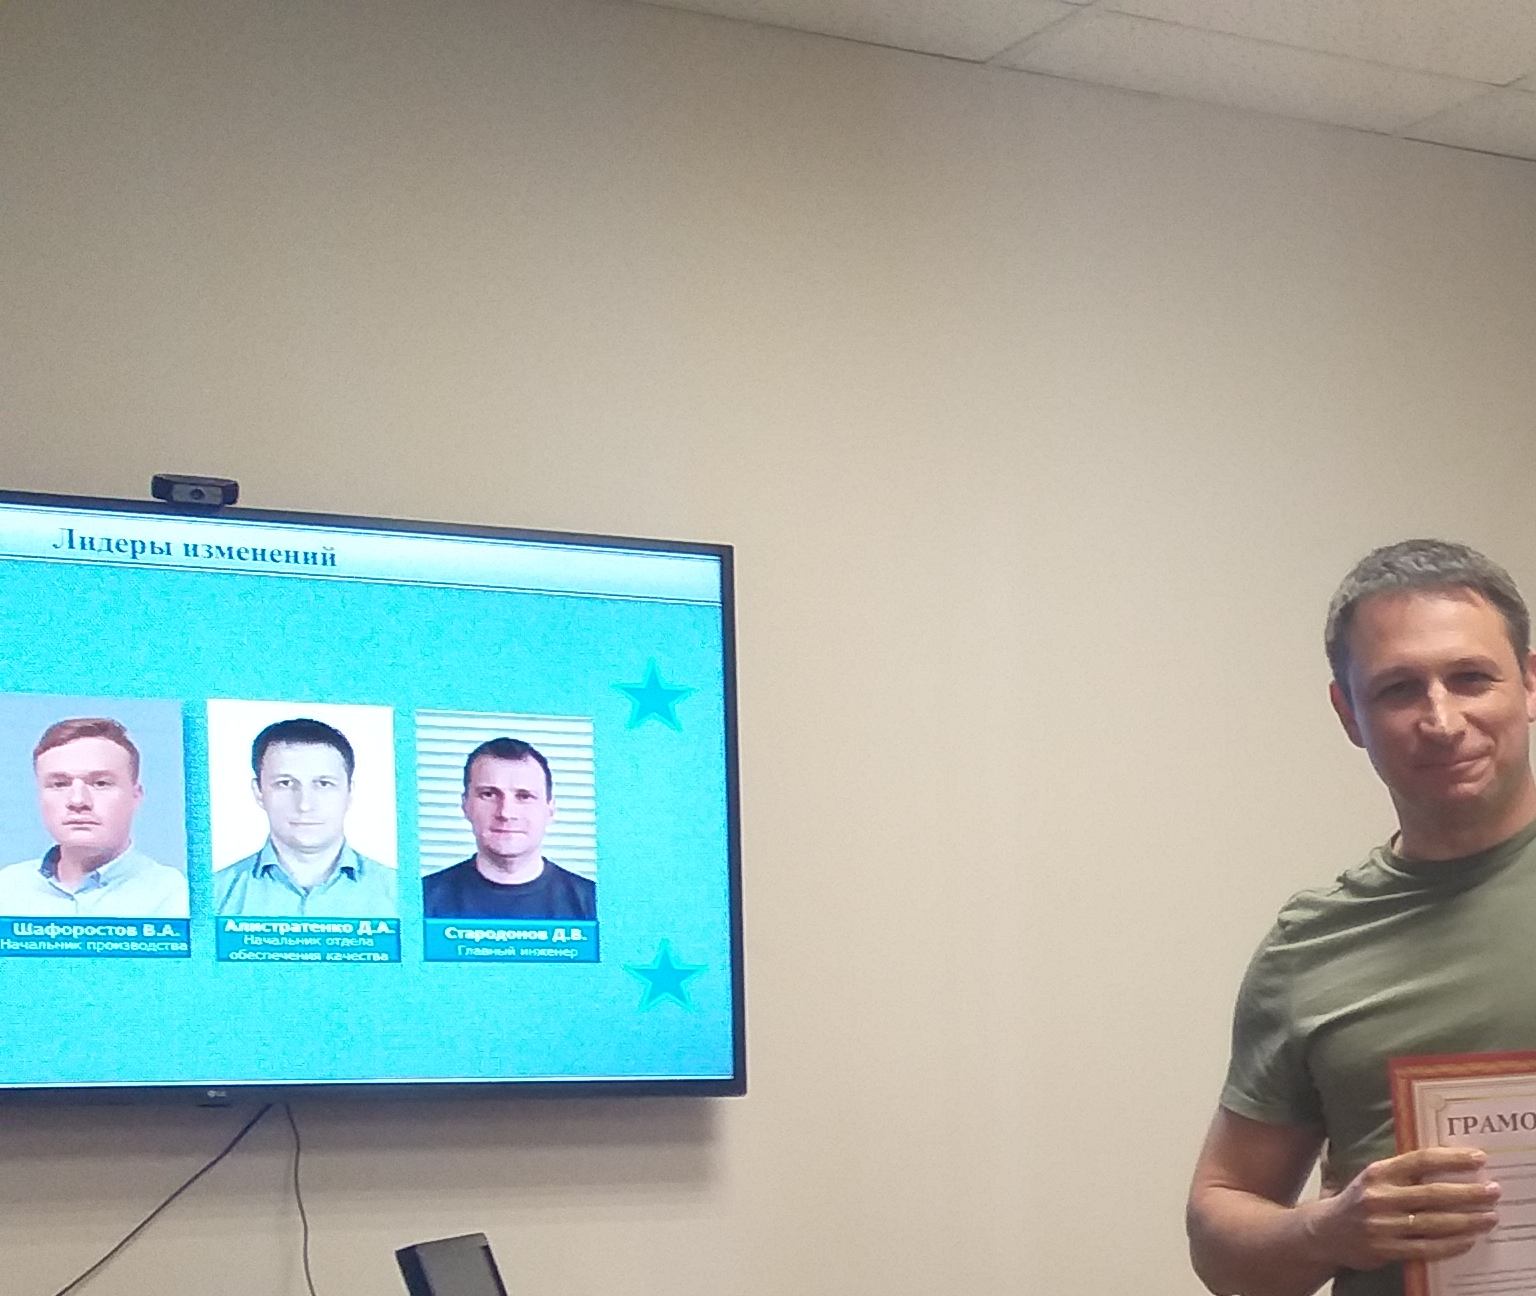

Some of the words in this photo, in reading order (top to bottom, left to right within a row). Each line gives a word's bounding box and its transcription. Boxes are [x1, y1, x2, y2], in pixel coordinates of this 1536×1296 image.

[52, 527, 173, 561] Лидеры
[184, 541, 338, 568] изменений
[13, 922, 138, 938] Шафоростов
[142, 924, 180, 937] В.А.
[225, 919, 354, 935] Алистратенко
[357, 921, 395, 936] Д.А.
[444, 926, 549, 942] Стародонов
[552, 928, 588, 942] Д.В.
[0, 938, 83, 951] Начальник
[86, 939, 188, 952] производства
[243, 934, 321, 947] Начальник
[325, 936, 374, 947] отдела
[228, 950, 322, 962] обеспечения
[325, 951, 389, 962] качества
[457, 945, 516, 958] Главный
[520, 946, 578, 959] инженер
